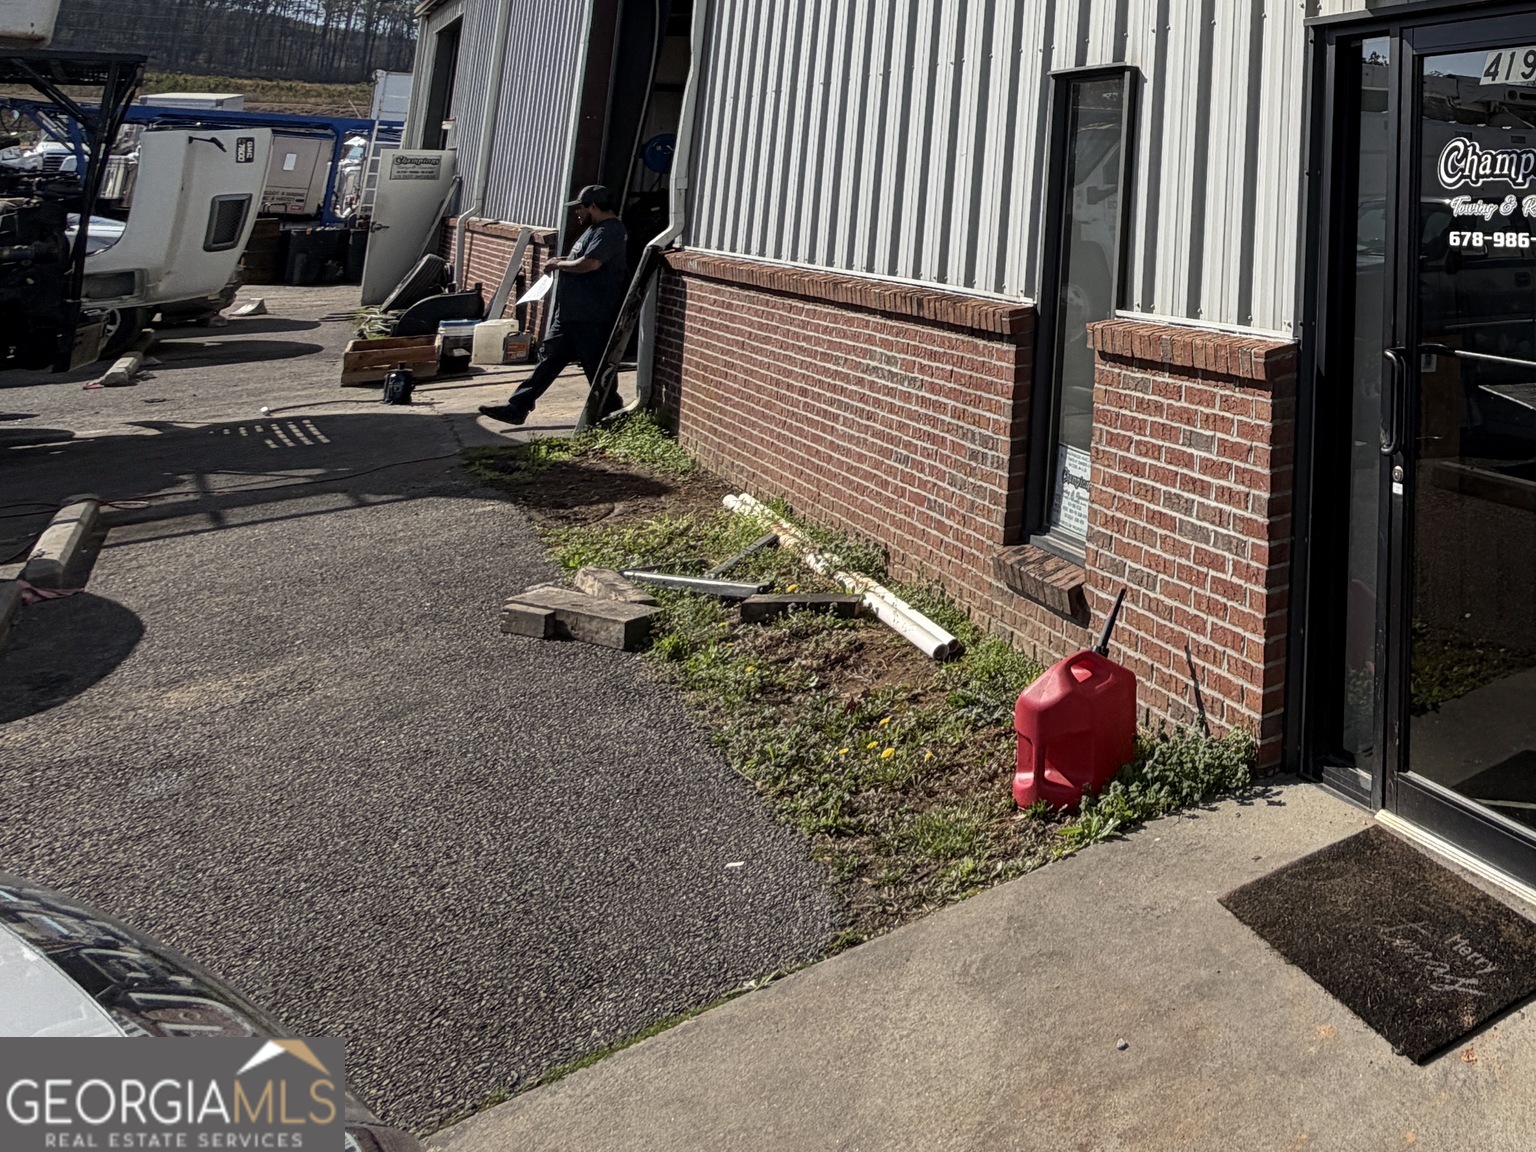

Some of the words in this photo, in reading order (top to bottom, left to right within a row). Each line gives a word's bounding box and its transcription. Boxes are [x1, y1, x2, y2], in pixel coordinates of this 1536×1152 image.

[1451, 195, 1498, 221] Towing
[1500, 195, 1517, 216] &
[1444, 934, 1499, 974] Merry
